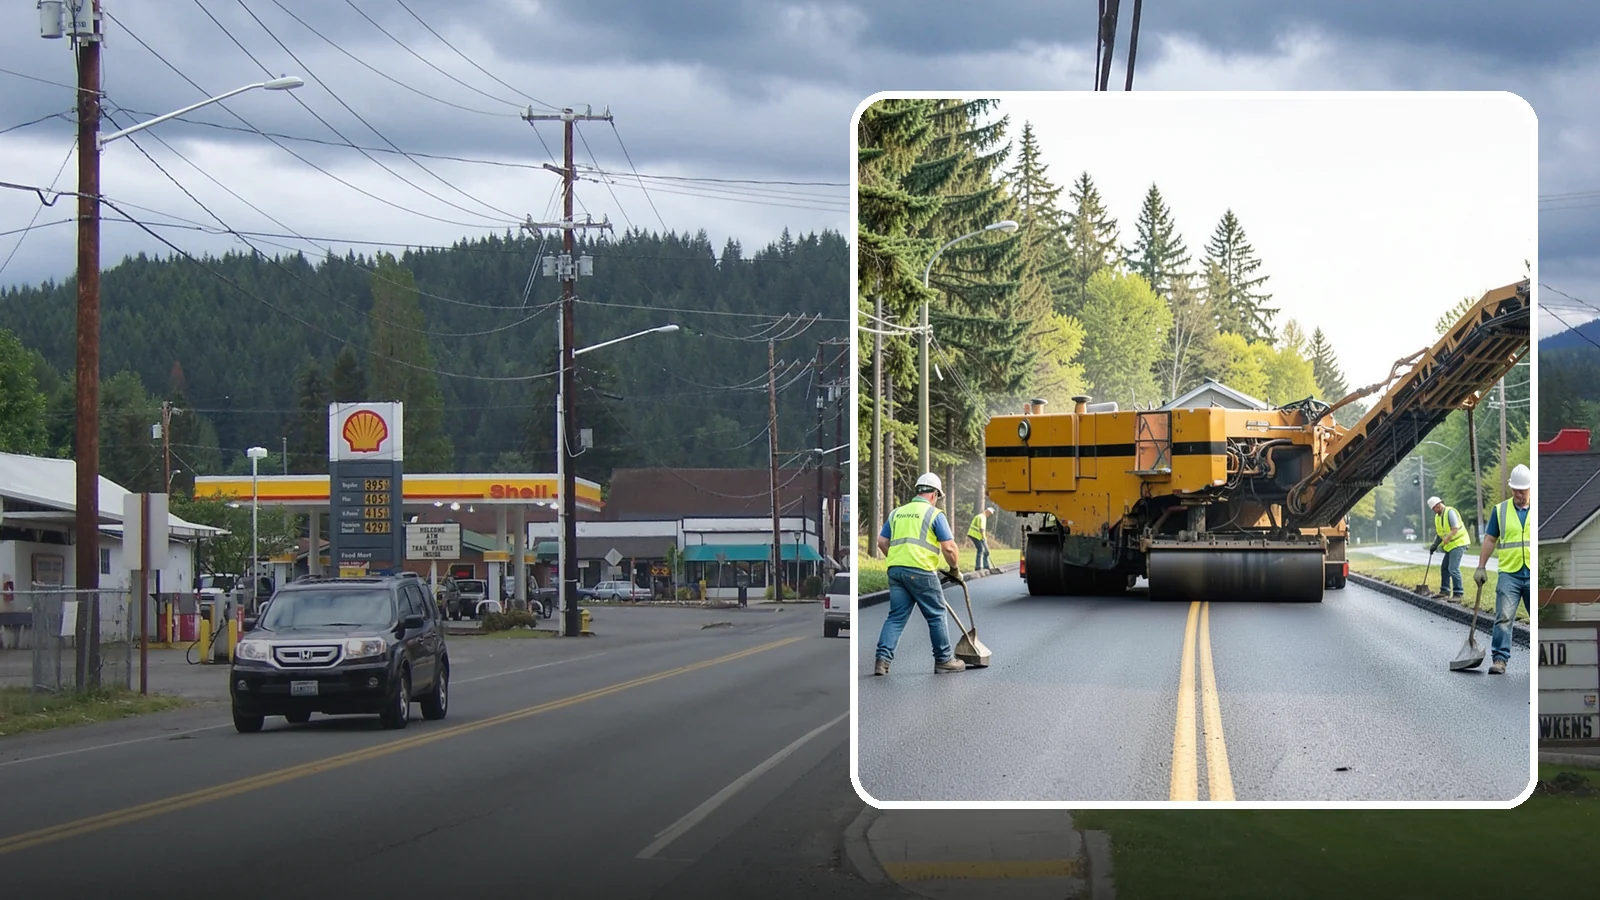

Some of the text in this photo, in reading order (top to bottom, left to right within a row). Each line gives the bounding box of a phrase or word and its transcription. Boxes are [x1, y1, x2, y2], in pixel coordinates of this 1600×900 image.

[366, 480, 383, 490] 395
[490, 484, 547, 499] Shell
[366, 494, 383, 504] 405
[366, 508, 383, 518] 415
[366, 522, 383, 533] 429
